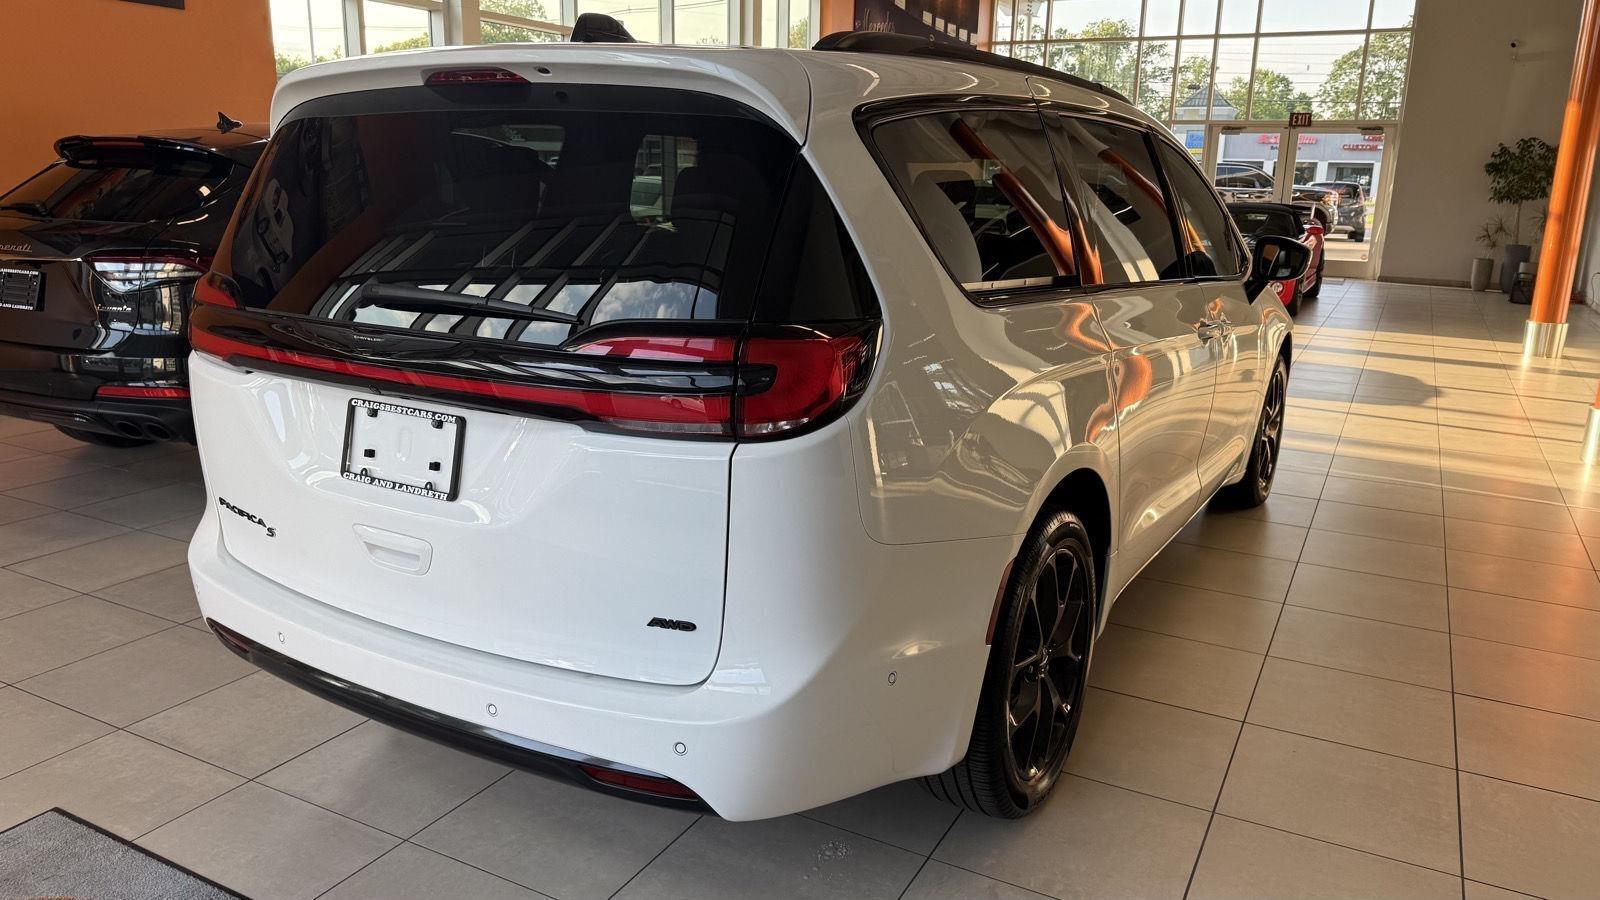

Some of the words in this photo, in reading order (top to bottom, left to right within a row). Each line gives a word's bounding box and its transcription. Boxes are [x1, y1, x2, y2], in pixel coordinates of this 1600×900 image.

[1292, 114, 1310, 126] EXIT
[351, 399, 457, 424] CRAIGSBESTCARS.COM
[343, 472, 371, 484] CRAIG
[372, 479, 394, 489] AND
[395, 483, 448, 501] LANDRETH
[219, 496, 267, 528] PACIFICA
[266, 527, 276, 537] S
[646, 616, 697, 632] AWD
